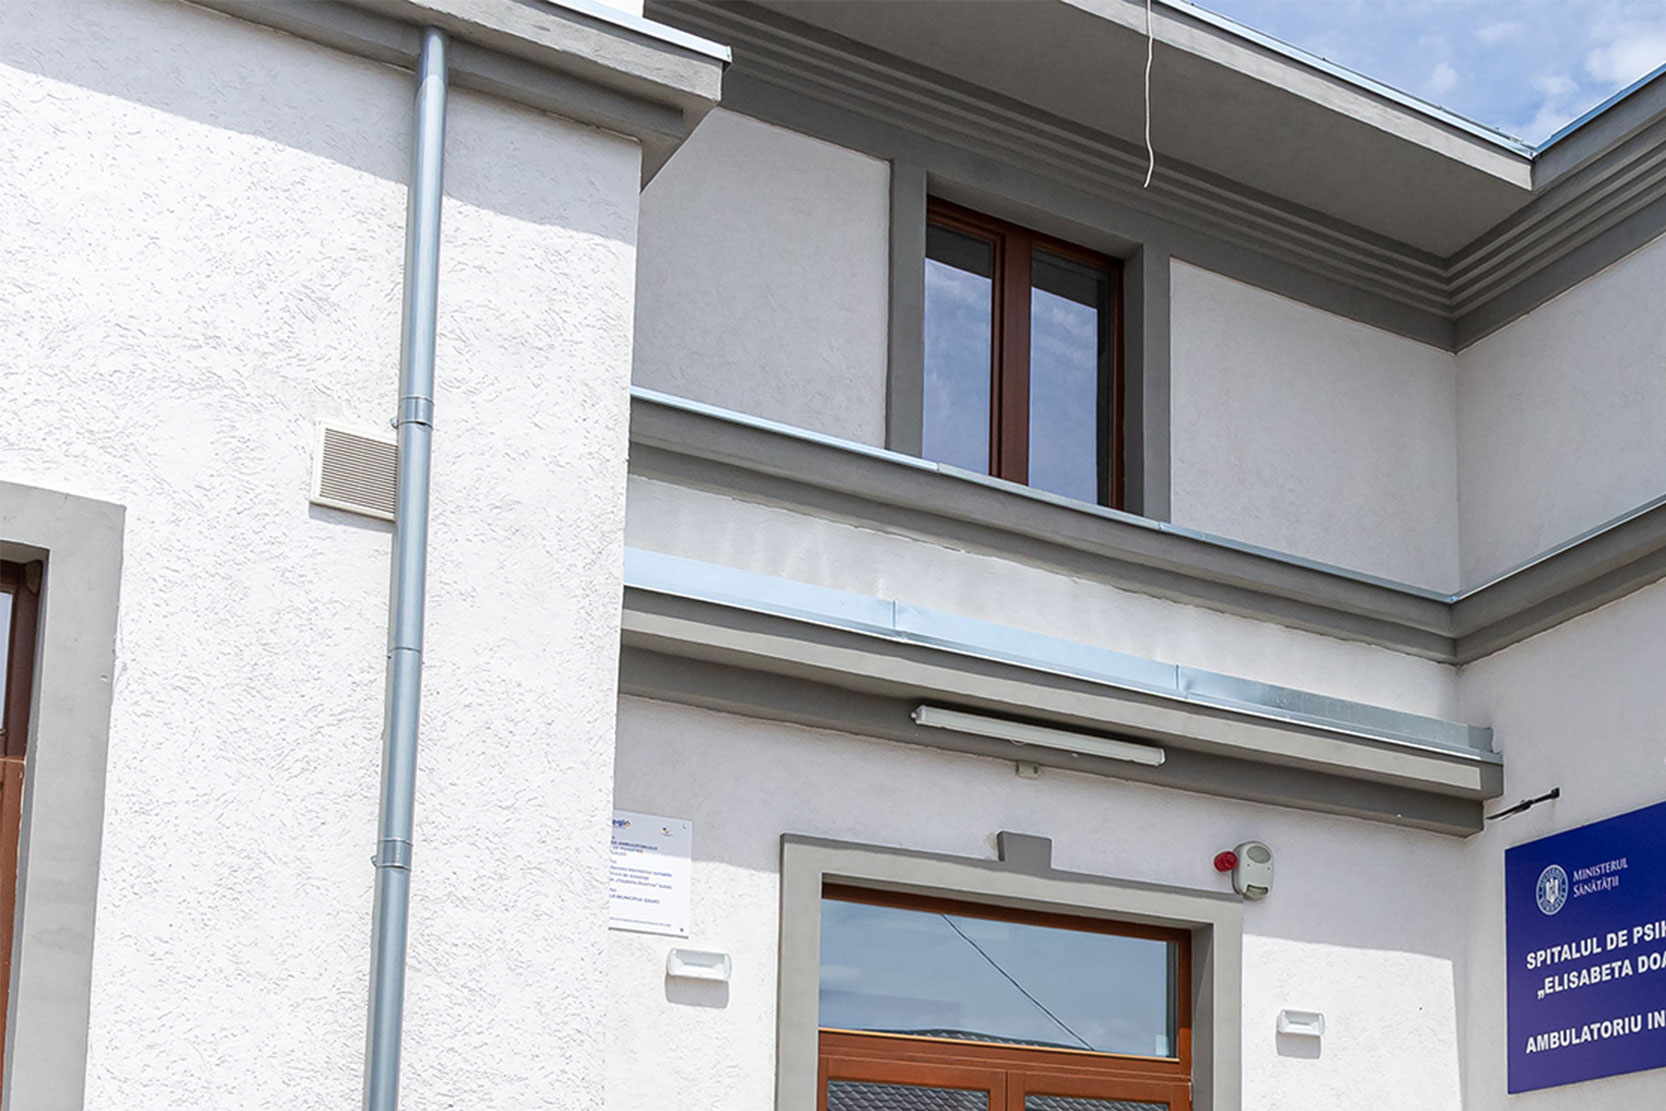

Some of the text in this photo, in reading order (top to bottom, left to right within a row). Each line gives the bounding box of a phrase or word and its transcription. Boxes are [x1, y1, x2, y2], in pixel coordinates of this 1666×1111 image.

[1573, 857, 1628, 882] MINISTERUL
[1526, 937, 1602, 970] SPITALUL
[1607, 929, 1628, 950] DE
[1526, 1014, 1642, 1054] AMBULATORIU
